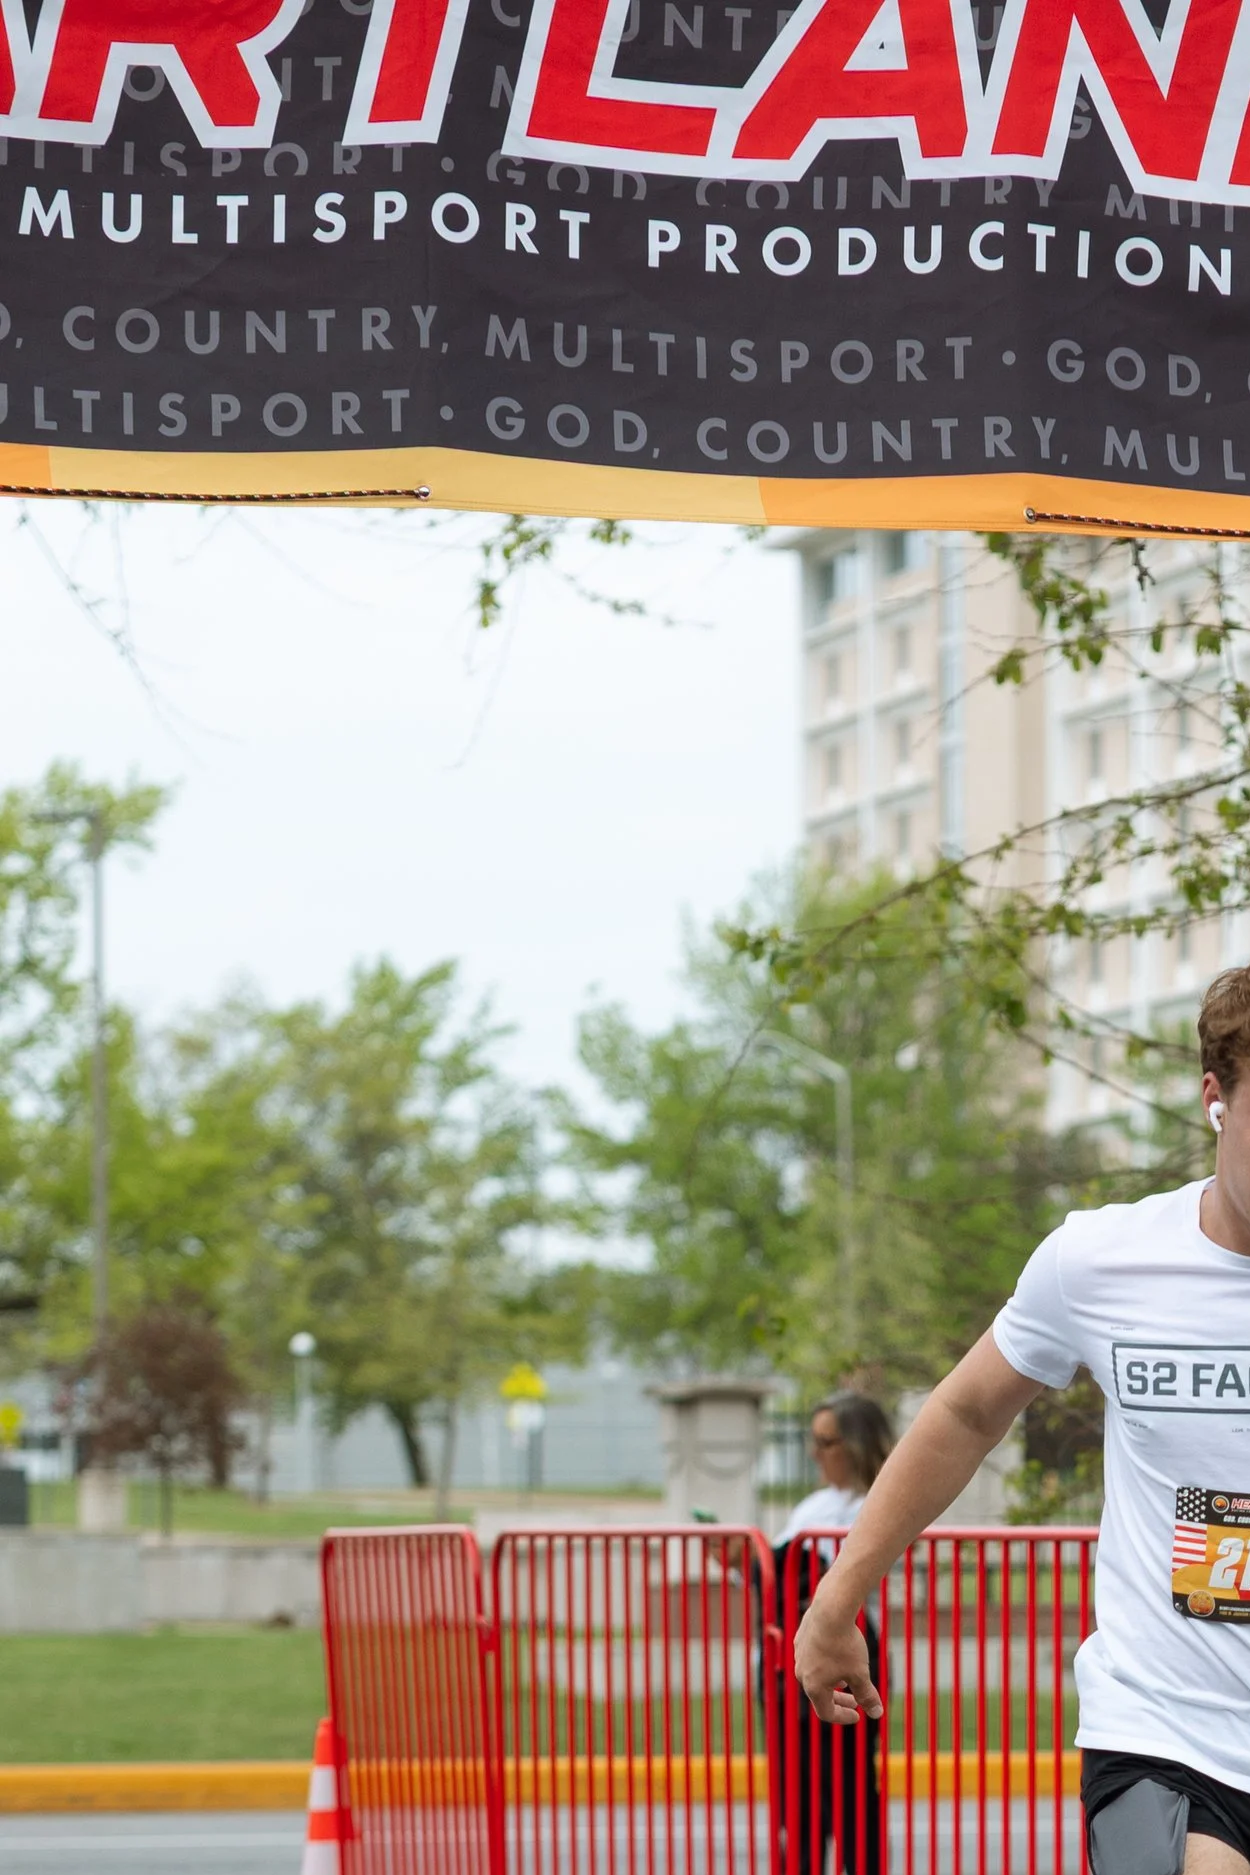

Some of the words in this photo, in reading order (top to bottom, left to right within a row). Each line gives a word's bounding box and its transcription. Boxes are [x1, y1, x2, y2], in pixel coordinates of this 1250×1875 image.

[18, 186, 590, 260] MULTISPORT
[62, 304, 449, 354] COUNTRY,
[485, 312, 974, 384] MULTISPORT
[1046, 338, 1213, 403] GOD,
[486, 396, 660, 459] GOD,
[696, 415, 1069, 466] COUNTRY,
[1126, 1361, 1177, 1396] S2
